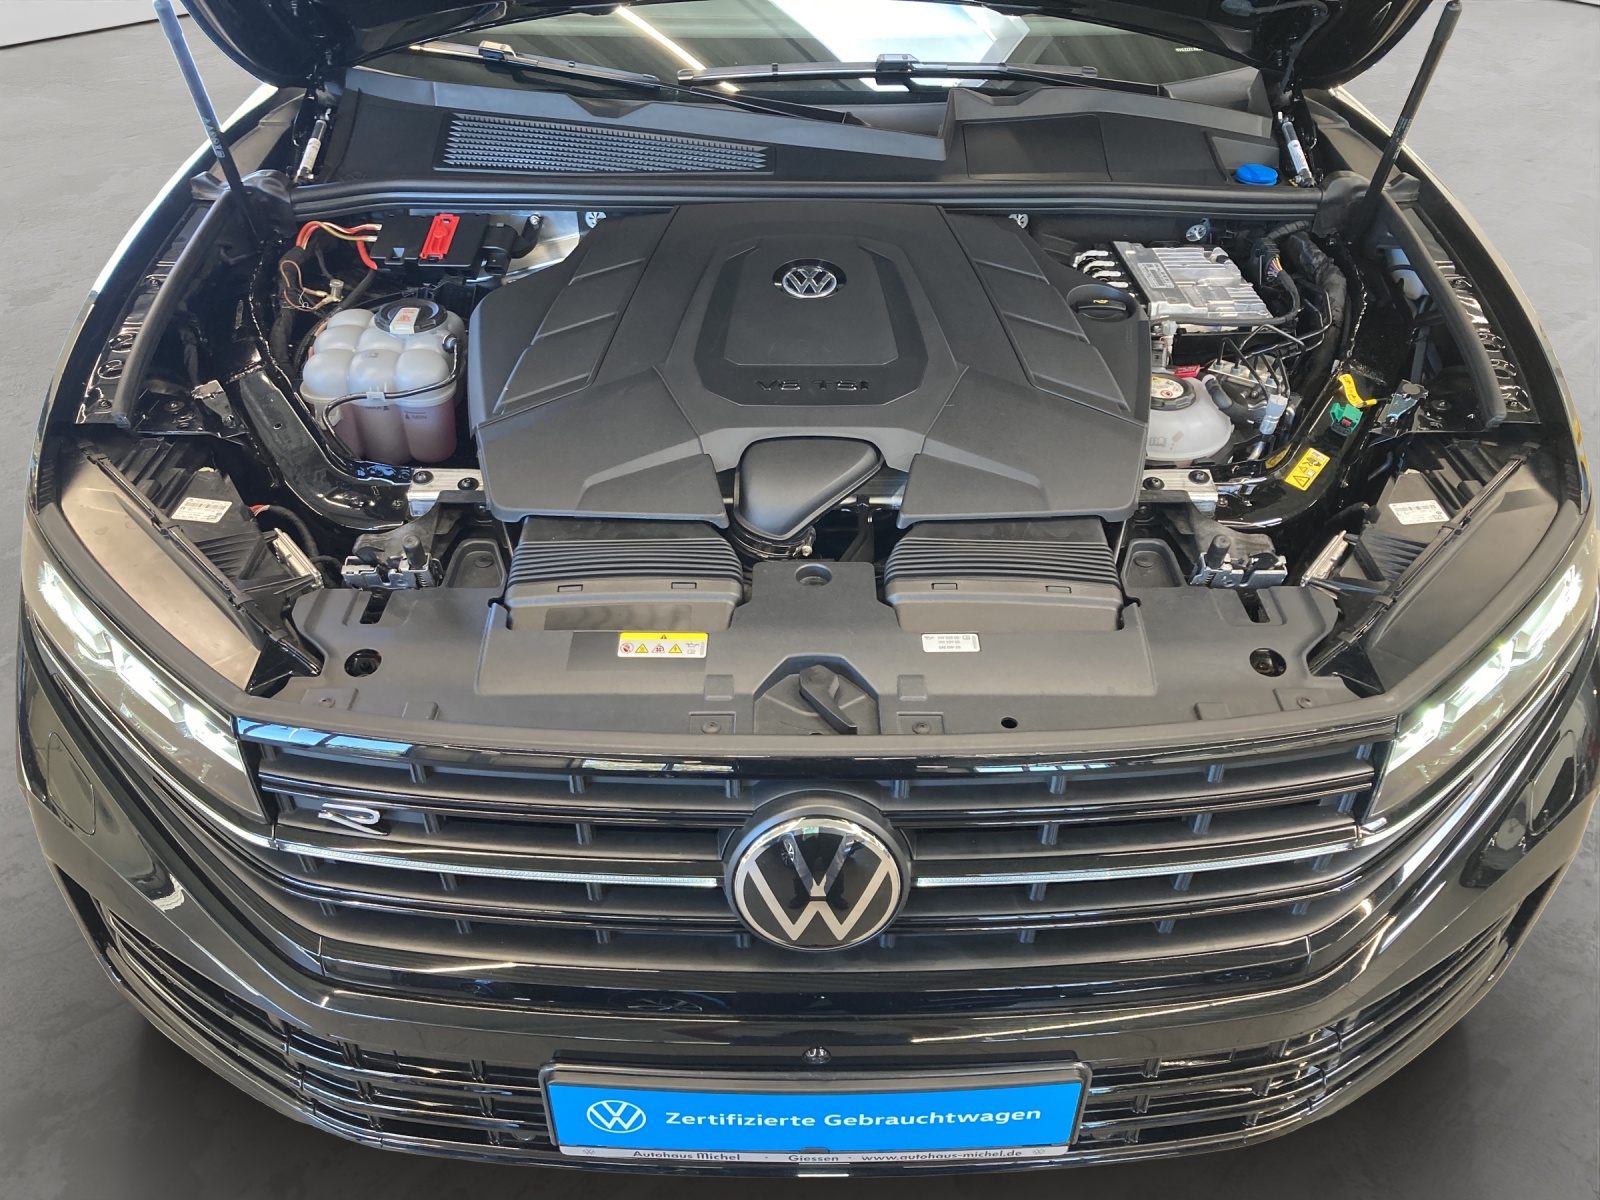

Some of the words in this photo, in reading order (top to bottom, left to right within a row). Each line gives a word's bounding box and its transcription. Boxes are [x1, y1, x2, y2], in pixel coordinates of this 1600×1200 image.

[782, 266, 838, 299] VW
[735, 817, 900, 951] VW
[586, 1100, 647, 1134] VW
[665, 1112, 816, 1127] Zertifizierte
[824, 1109, 1041, 1126] Gebrauchtwagen
[632, 1150, 693, 1159] Autohaus
[696, 1152, 741, 1161] Michel
[788, 1154, 839, 1162] Giessen
[861, 1149, 1022, 1161] www.autohaus-michel.de
